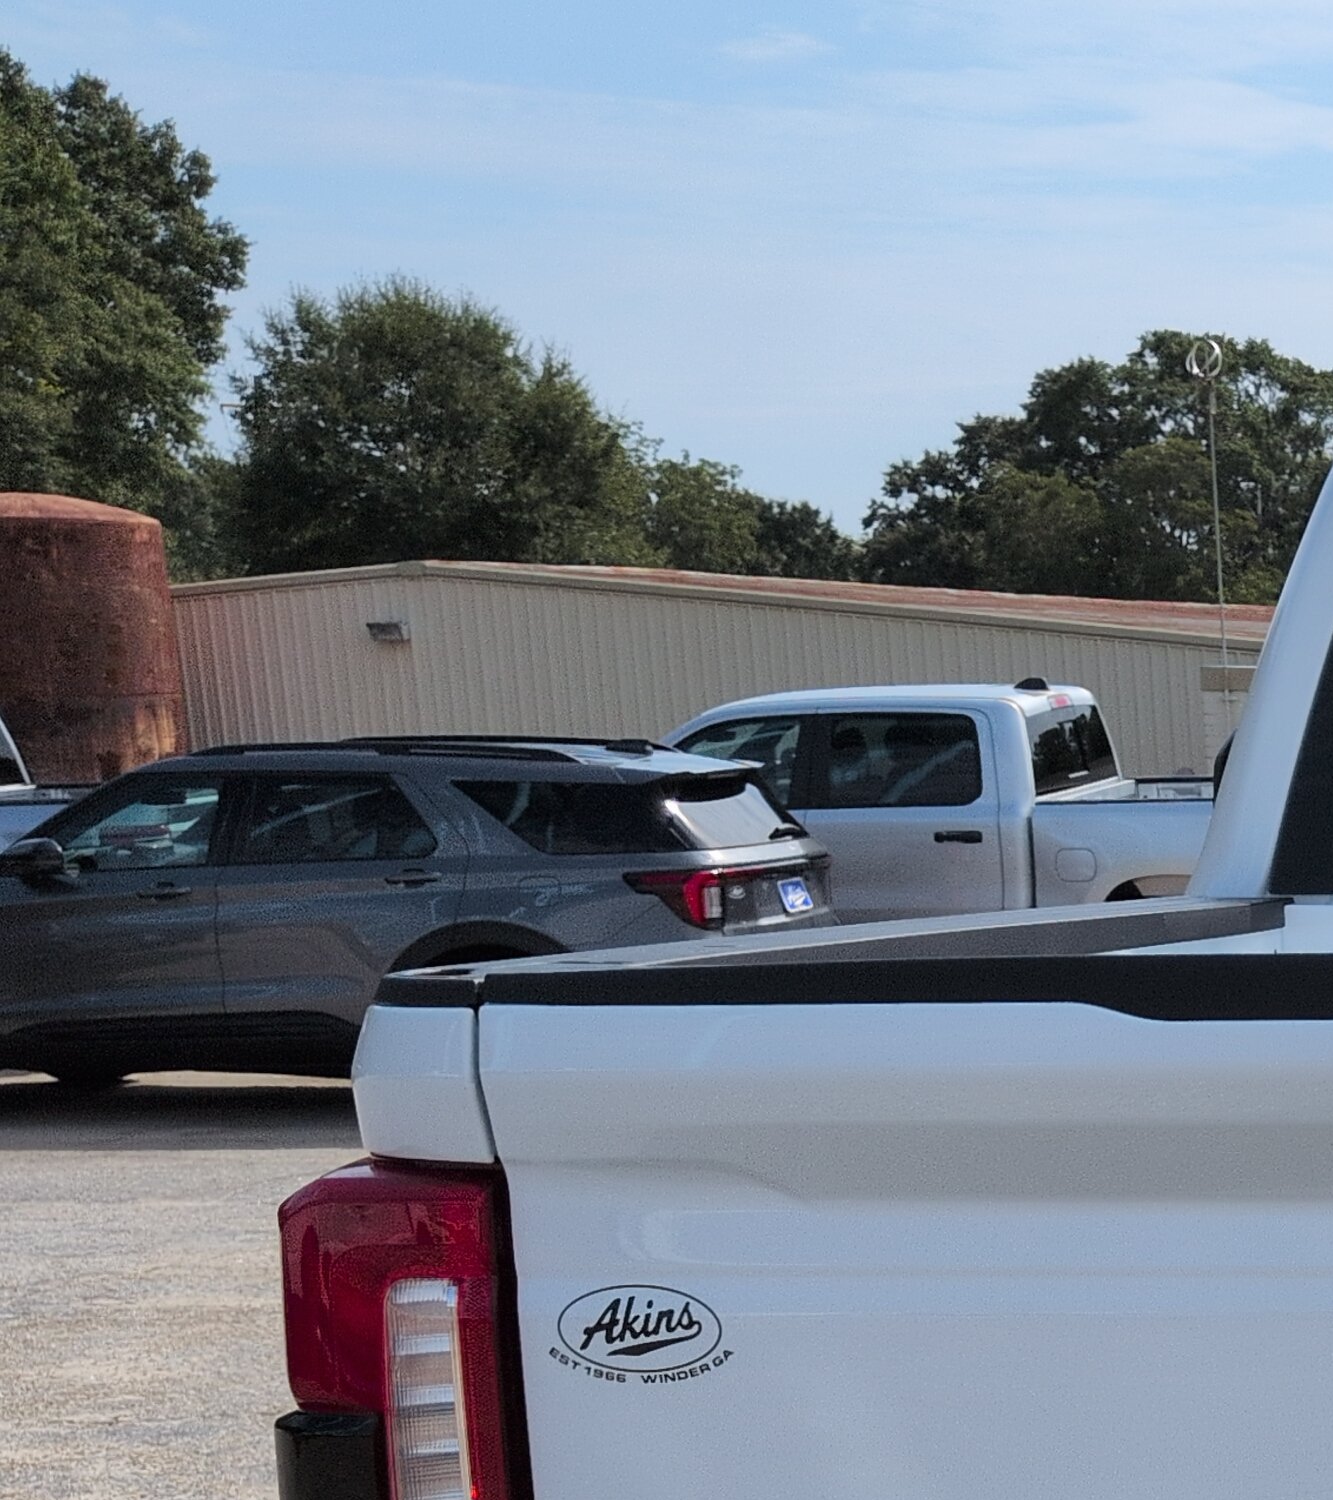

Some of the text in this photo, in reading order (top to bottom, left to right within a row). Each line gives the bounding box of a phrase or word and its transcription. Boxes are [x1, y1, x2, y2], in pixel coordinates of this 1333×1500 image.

[580, 1296, 702, 1355] Akins
[549, 1347, 735, 1384] EST 1966 WINDER GA
